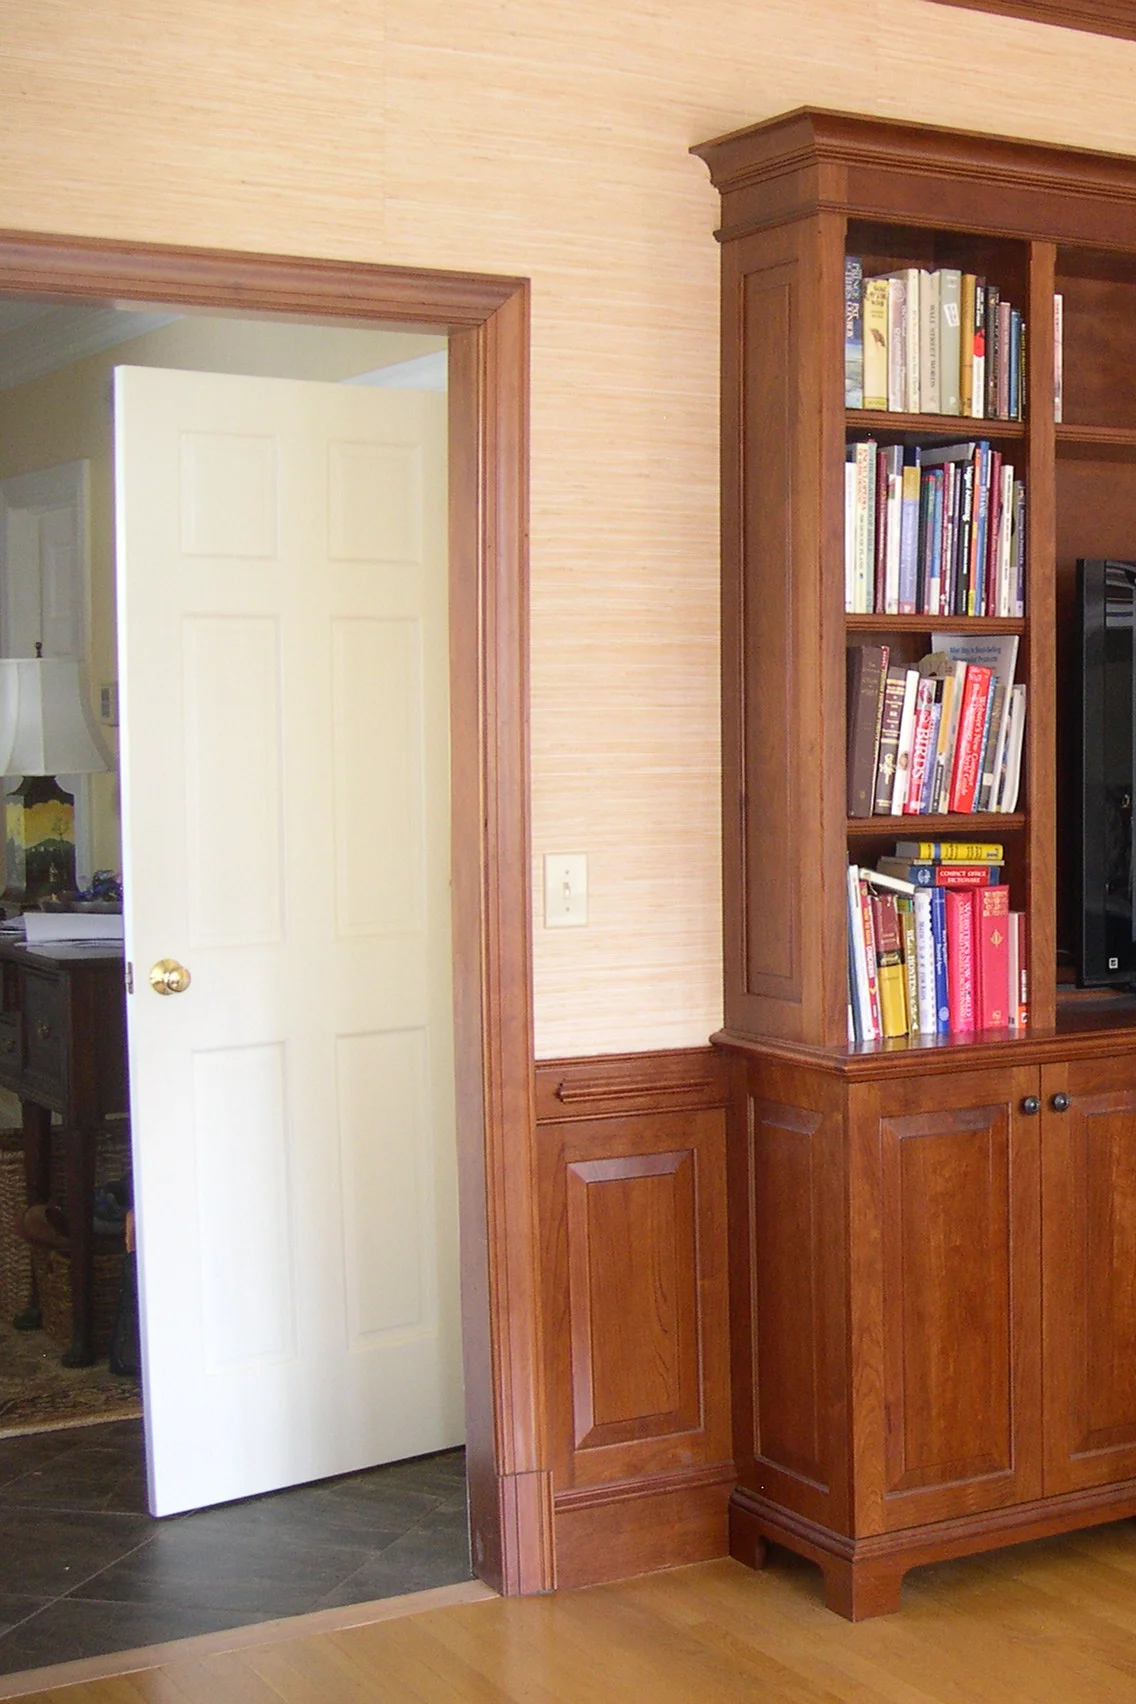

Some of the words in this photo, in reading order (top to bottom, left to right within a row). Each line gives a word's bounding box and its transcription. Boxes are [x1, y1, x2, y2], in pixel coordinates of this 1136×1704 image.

[911, 727, 929, 780] BIRDS
[964, 901, 972, 955] WEBSTER'S
[866, 945, 875, 979] CHICKENS
[907, 955, 917, 997] HOSTESS
[964, 956, 972, 979] NEW
[964, 980, 972, 1017] WORLD
